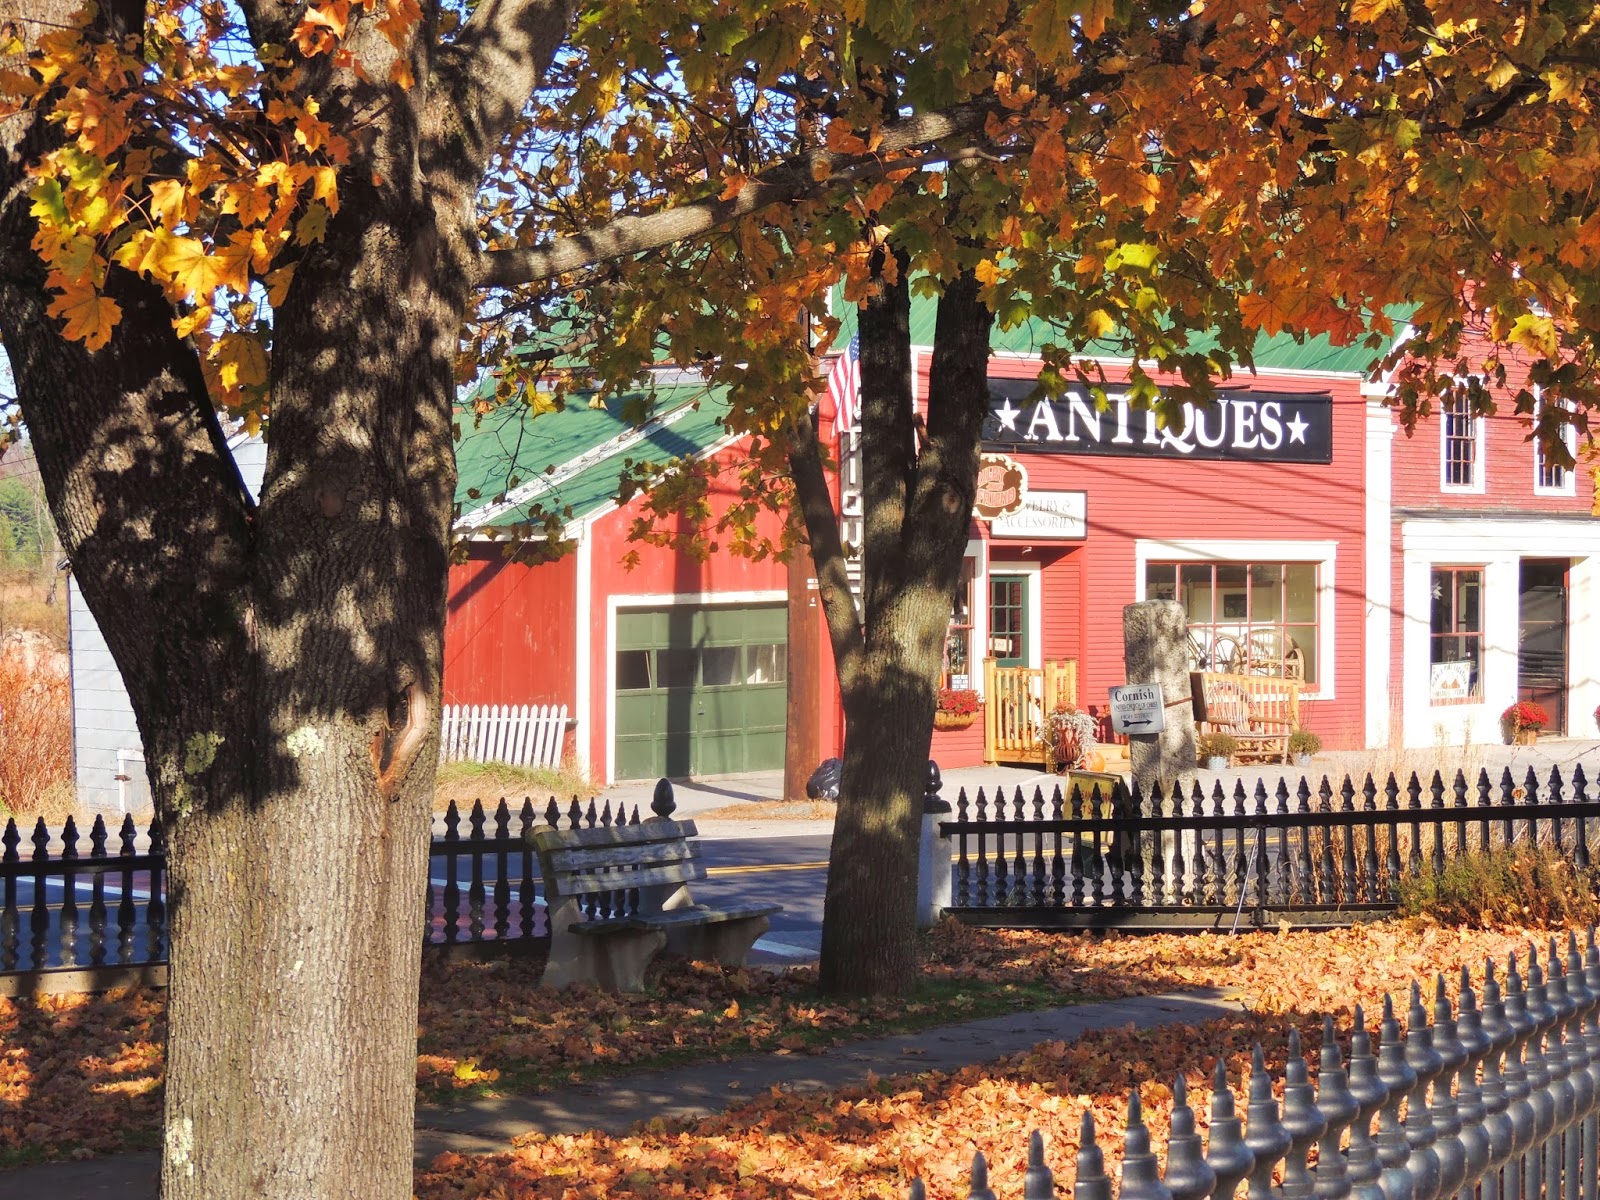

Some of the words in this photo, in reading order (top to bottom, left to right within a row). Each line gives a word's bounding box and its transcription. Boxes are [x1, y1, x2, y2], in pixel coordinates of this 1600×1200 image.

[1024, 391, 1283, 453] ANTIQUES
[1002, 516, 1076, 529] ACCESSORIES
[1115, 688, 1154, 702] Cornish
